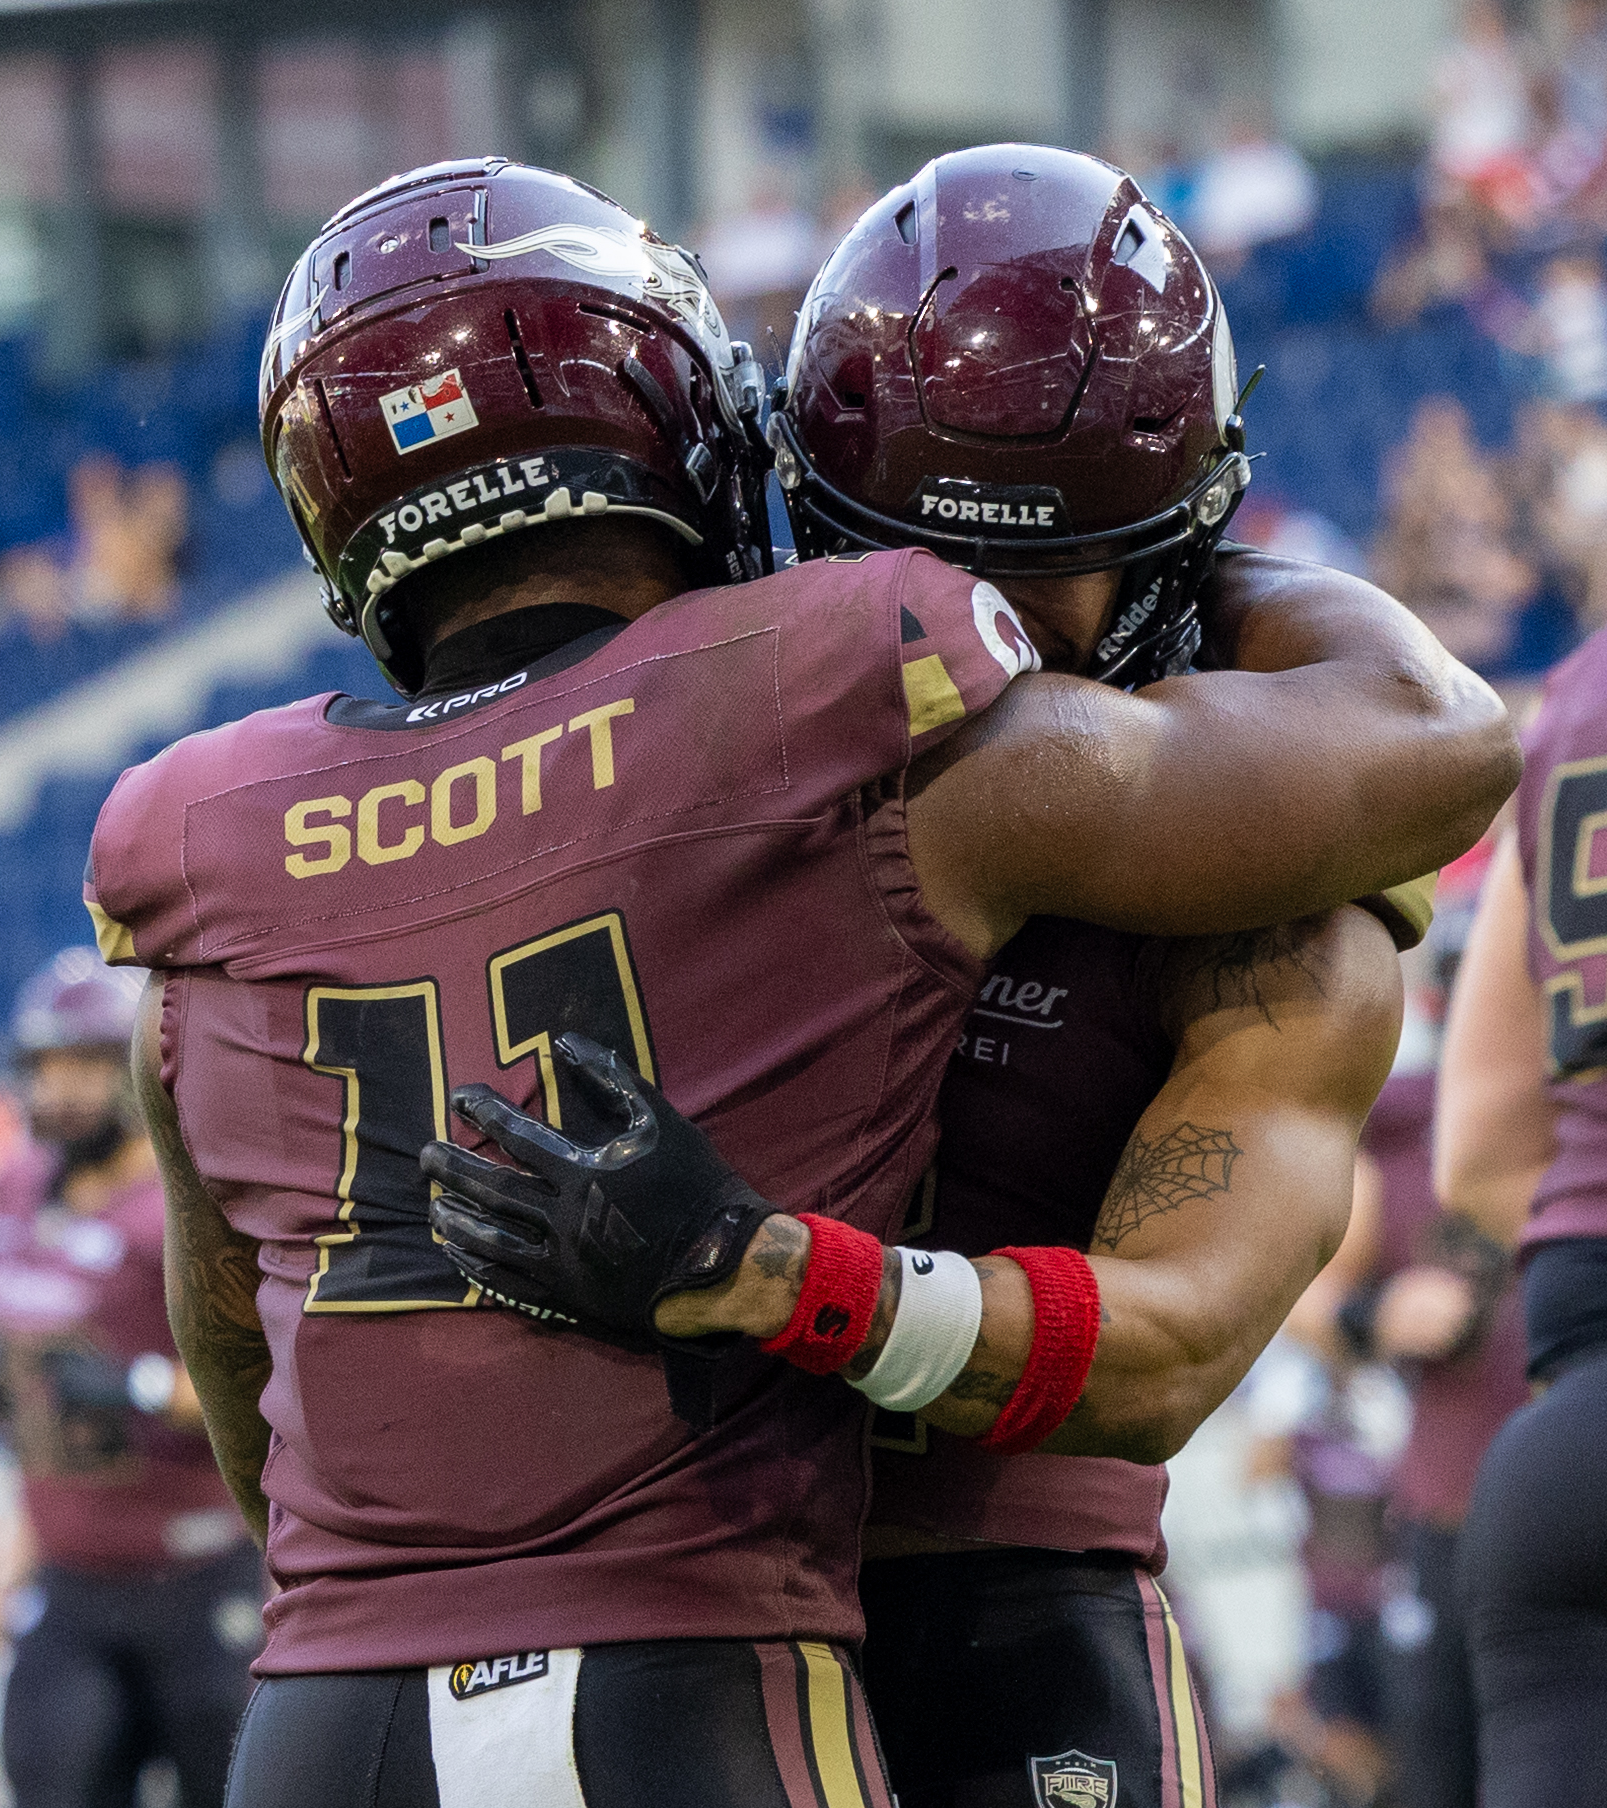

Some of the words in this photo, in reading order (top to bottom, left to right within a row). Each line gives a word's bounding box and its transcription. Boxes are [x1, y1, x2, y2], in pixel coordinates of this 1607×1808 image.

[378, 456, 549, 546] FORELLE
[920, 493, 1056, 528] FORELLE
[283, 697, 635, 880] SCOTT
[464, 1652, 545, 1693] AFLE
[1041, 1773, 1109, 1802] FIRE
